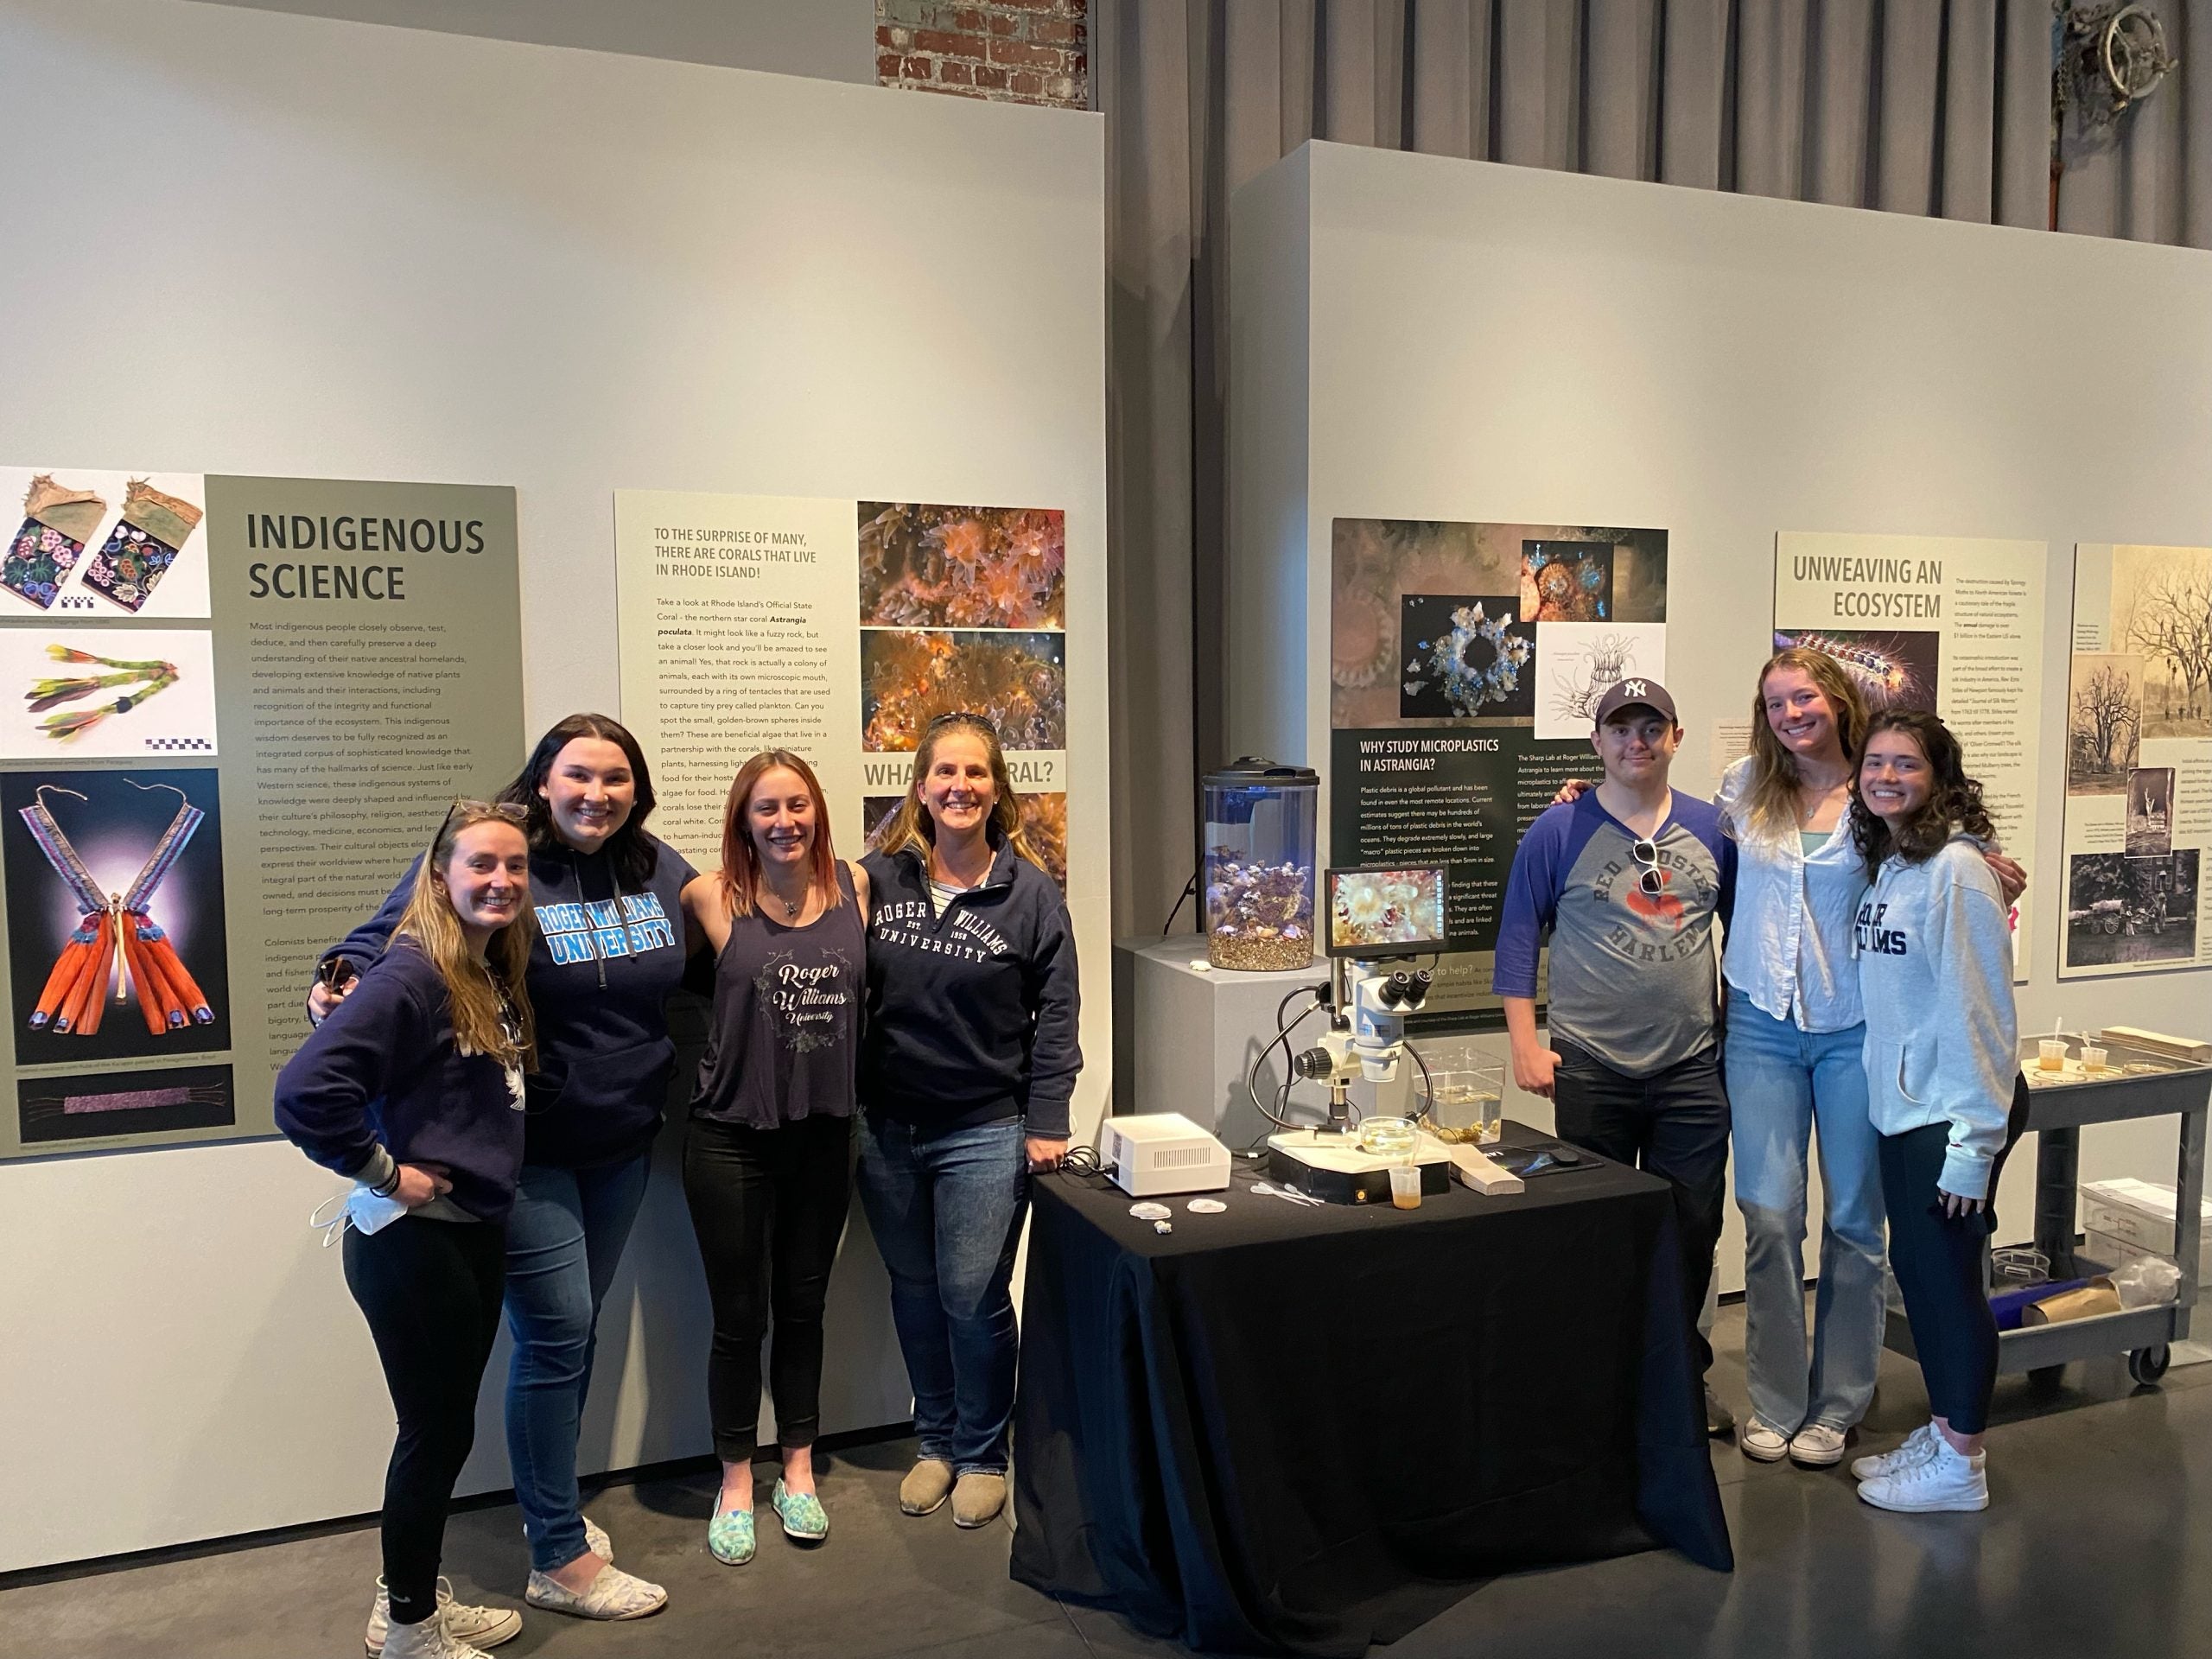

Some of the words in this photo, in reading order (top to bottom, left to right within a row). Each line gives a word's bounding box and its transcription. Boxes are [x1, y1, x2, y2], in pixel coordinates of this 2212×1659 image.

[247, 513, 484, 555] INDIGENOUS
[653, 527, 669, 539] TO
[671, 528, 693, 540] THE
[696, 529, 751, 543] SURPRISE
[753, 531, 768, 543] OF
[772, 532, 806, 546] MANY,
[654, 545, 691, 558] THERE
[693, 547, 715, 559] ARE
[718, 548, 762, 561] CORALS
[763, 550, 791, 562] THAT
[793, 551, 816, 563] LIVE
[656, 563, 668, 575] IN
[671, 564, 713, 576] RHODE
[715, 565, 760, 578] ISLAND!
[1794, 556, 1911, 583] UNWEAVING
[1916, 560, 1942, 584] AN
[249, 563, 404, 600] SCIENCE
[1834, 592, 1941, 618] ECOSYSTEM
[274, 622, 323, 632] indigenous
[325, 623, 356, 632] people
[358, 623, 387, 632] closely
[769, 616, 807, 625] Astrangia
[703, 629, 725, 638] might
[766, 630, 785, 639] fuzzy
[250, 638, 287, 646] deduce,
[329, 639, 366, 648] carefully
[414, 639, 436, 648] deep
[251, 654, 315, 664] understanding
[418, 655, 467, 664] homelands,
[251, 670, 302, 680] developing
[346, 671, 395, 679] knowledge
[435, 671, 461, 679] plants
[716, 715, 769, 725] golden-brown
[255, 749, 302, 760] integrated
[346, 748, 404, 758] sophisticated
[404, 747, 452, 757] knowledge
[1359, 741, 1385, 753] WHY
[1386, 741, 1419, 753] STUDY
[1421, 739, 1499, 752] MICROPLASTICS
[1360, 760, 1371, 771] IN
[1373, 758, 1435, 771] ASTRANGIA?
[864, 764, 913, 785] WHA
[260, 845, 317, 854] perspectives.
[378, 841, 409, 849] objects
[1593, 860, 1623, 902] RED
[533, 903, 588, 935] ROGER
[584, 892, 664, 931] WILLIAMS
[874, 901, 927, 926] ROGER
[953, 909, 1008, 956] WILLIAMS
[906, 920, 921, 931] EST.
[545, 918, 676, 965] UNIVERSITY
[880, 928, 986, 963] UNIVERSITY
[1609, 925, 1702, 963] HARLEM
[779, 964, 839, 988] Roger
[1449, 965, 1473, 976] help?
[772, 988, 846, 1011] Williams
[785, 1011, 833, 1027] University
